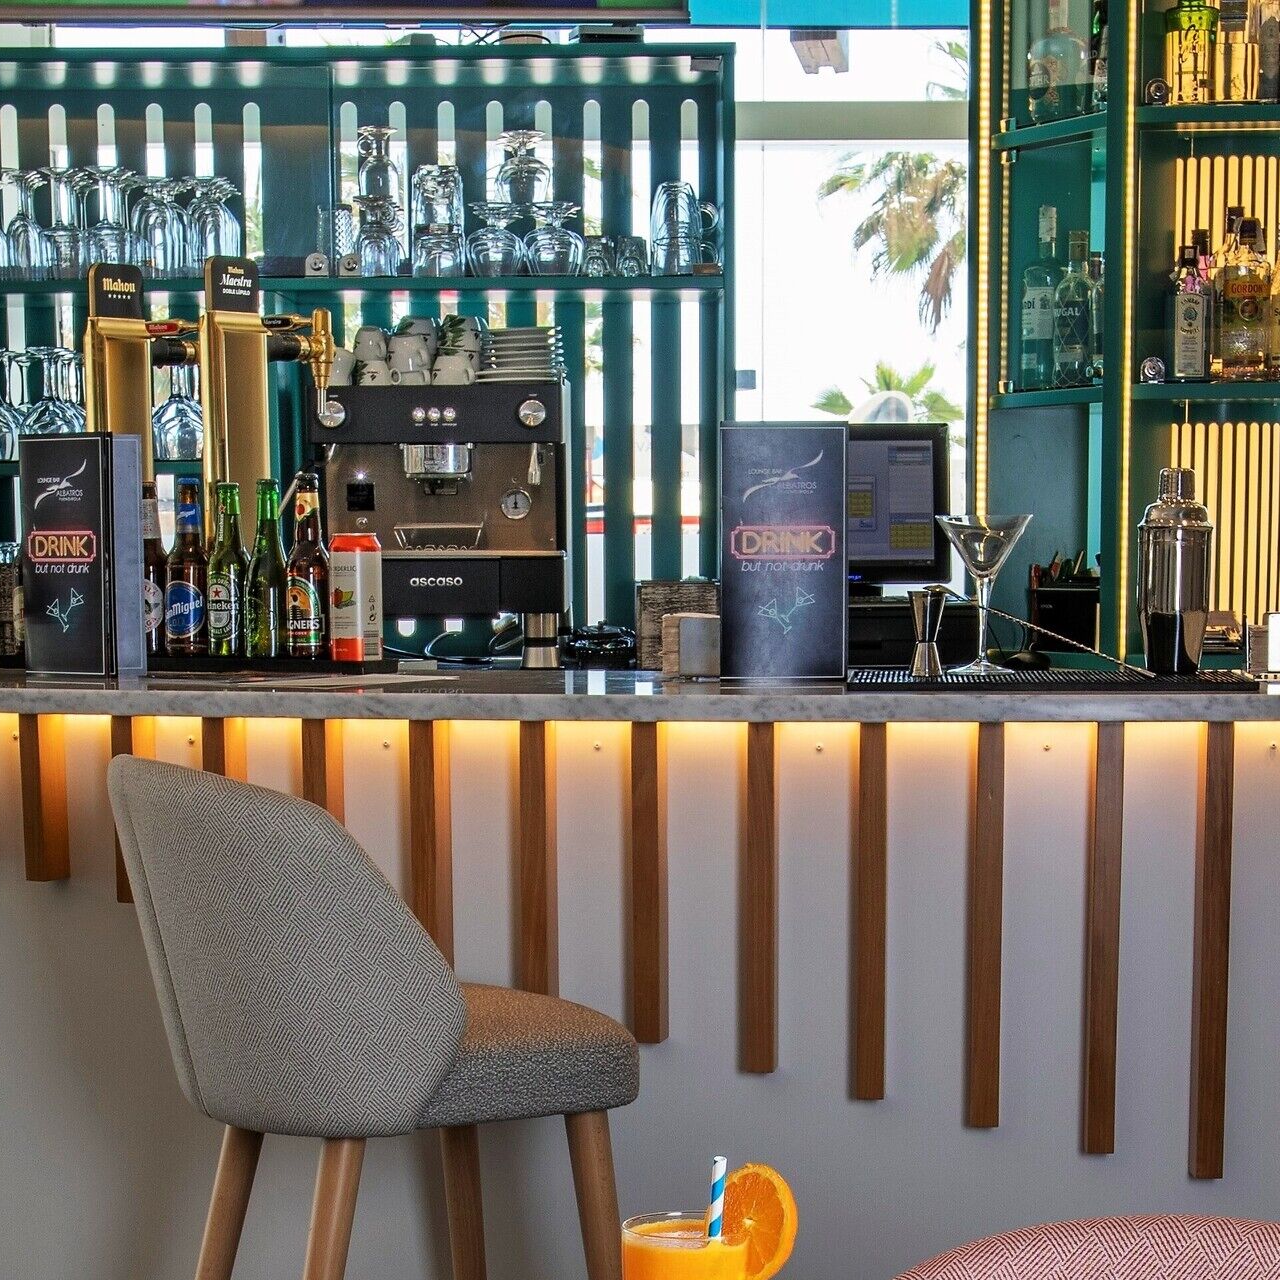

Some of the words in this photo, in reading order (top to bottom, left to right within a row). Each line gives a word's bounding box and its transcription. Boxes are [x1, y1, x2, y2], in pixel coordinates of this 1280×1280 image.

[102, 277, 136, 292] Mahou
[219, 273, 252, 288] Maestra
[35, 535, 89, 557] DRINK
[742, 531, 823, 554] DRINK
[35, 563, 48, 573] but
[50, 564, 65, 573] not
[67, 563, 89, 574] drunk
[741, 560, 762, 572] but
[765, 561, 788, 571] not
[790, 560, 824, 572] drunk
[410, 576, 463, 587] ascaso
[172, 595, 203, 617] Miguel
